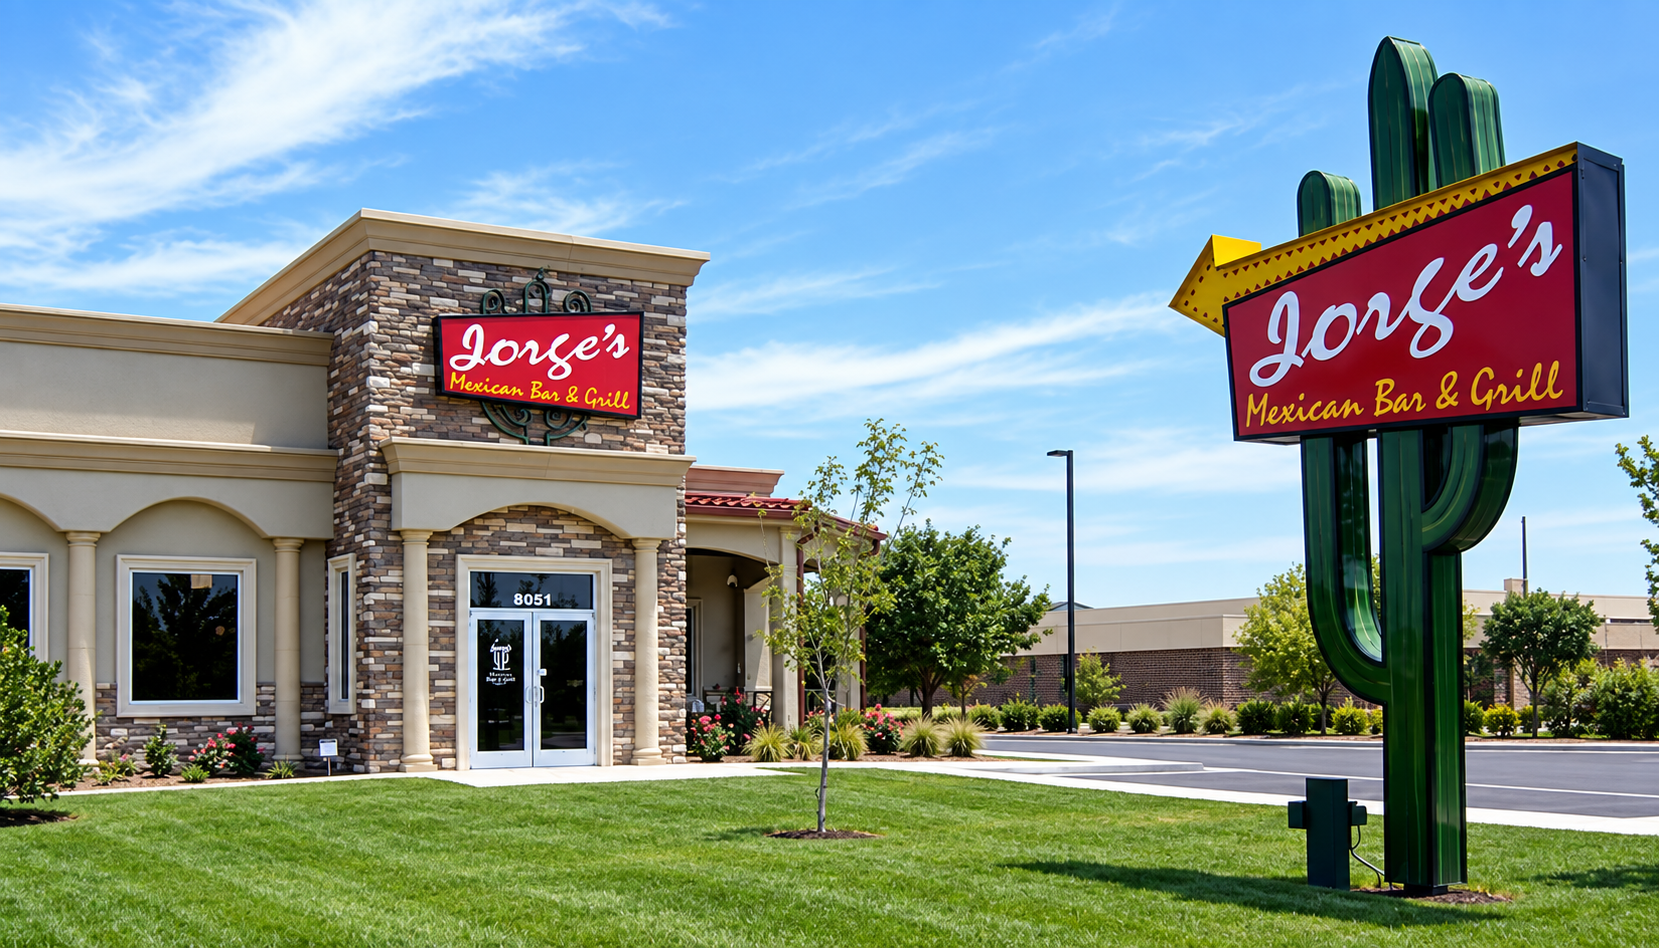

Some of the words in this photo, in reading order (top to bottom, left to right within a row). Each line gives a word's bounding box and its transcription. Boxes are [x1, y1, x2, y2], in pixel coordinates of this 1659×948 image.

[1248, 204, 1563, 388] Jorge's
[449, 323, 630, 381] Jorge's
[449, 371, 524, 397] Mexican
[529, 380, 561, 402] Bar
[565, 385, 579, 403] &
[584, 386, 631, 410] Grill
[1245, 393, 1365, 428] Mexican
[1373, 378, 1427, 417] Bar
[1435, 370, 1459, 410] &
[1470, 360, 1564, 411] Grill
[513, 593, 552, 606] 8051
